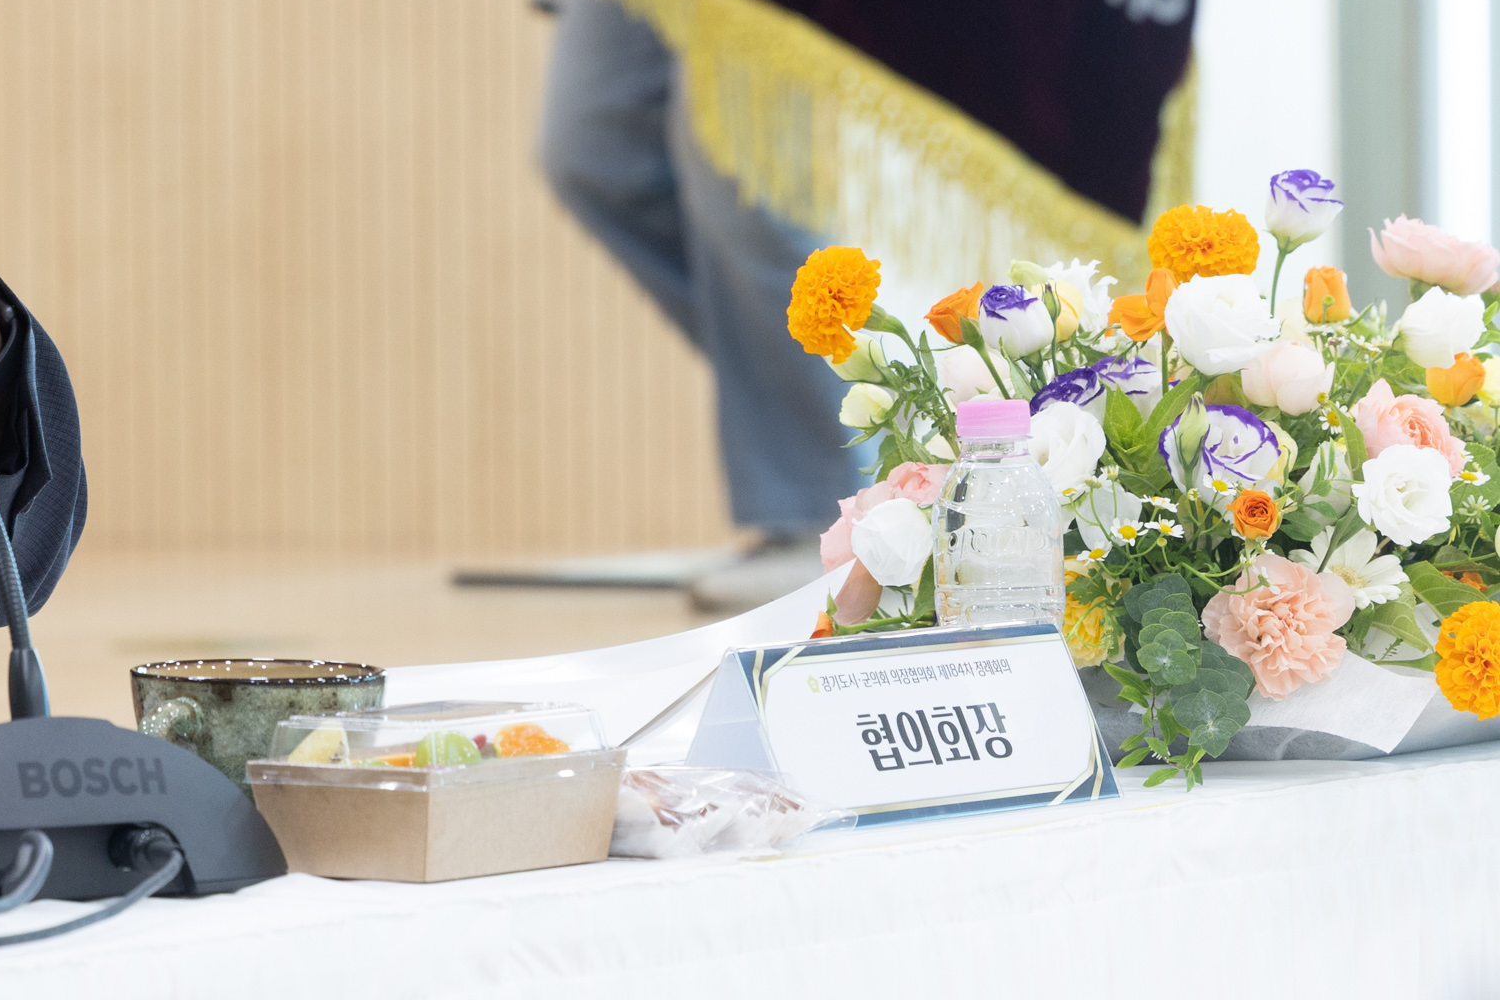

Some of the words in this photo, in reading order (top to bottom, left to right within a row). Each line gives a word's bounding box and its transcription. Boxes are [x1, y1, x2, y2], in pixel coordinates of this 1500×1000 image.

[889, 664, 938, 685] 의장협의회
[938, 661, 976, 681] 제184차
[973, 657, 1013, 677] 정례회의
[856, 702, 1014, 772] 협의회장
[16, 757, 168, 800] BOSCH
